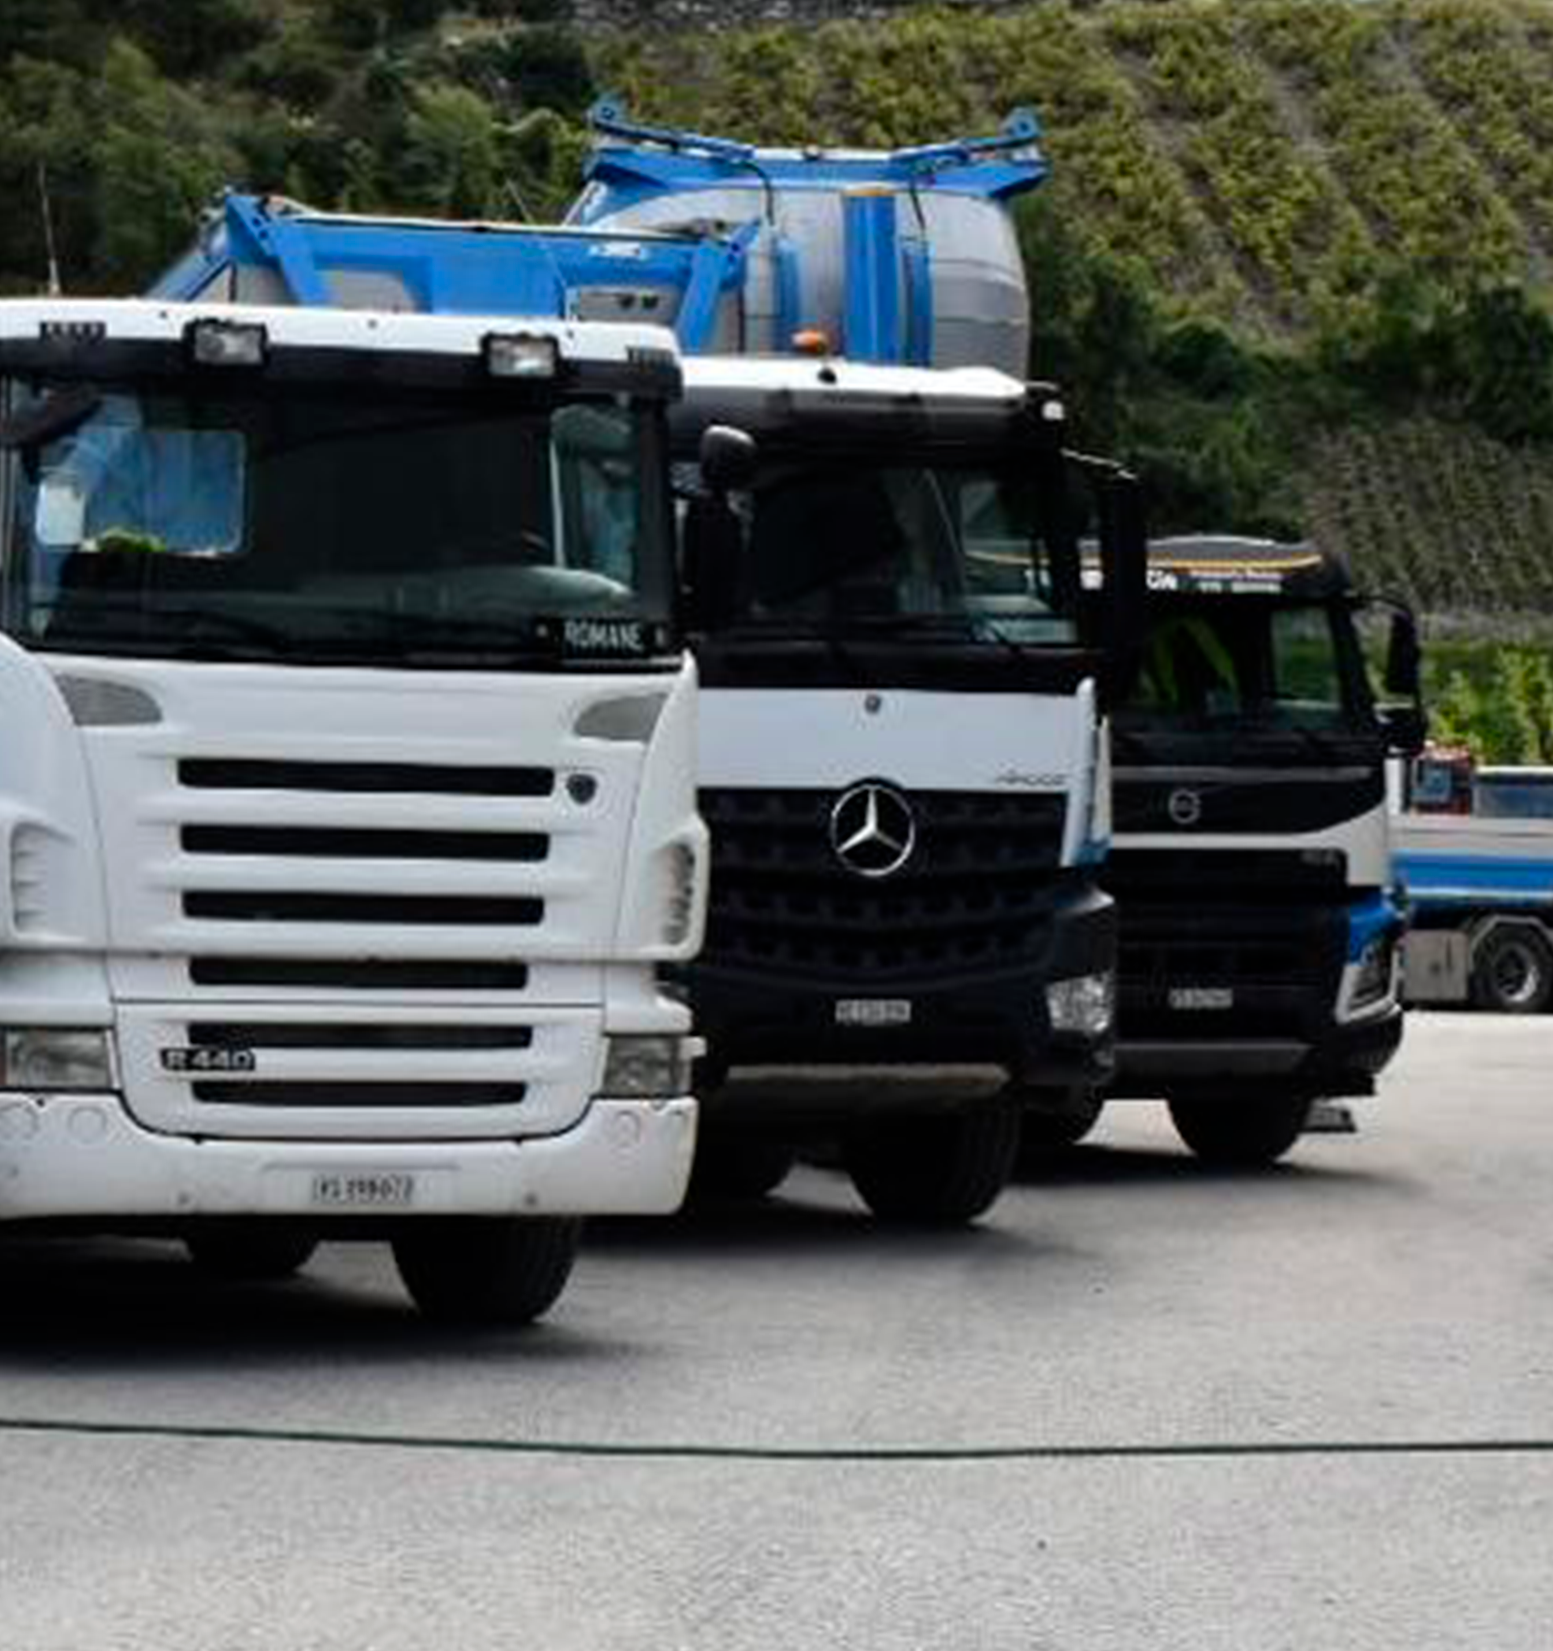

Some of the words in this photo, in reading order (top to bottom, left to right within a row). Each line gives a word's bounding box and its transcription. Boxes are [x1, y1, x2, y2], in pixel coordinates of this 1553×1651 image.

[564, 621, 644, 650] ROMANE
[167, 1050, 187, 1071] R
[191, 1050, 252, 1071] 440
